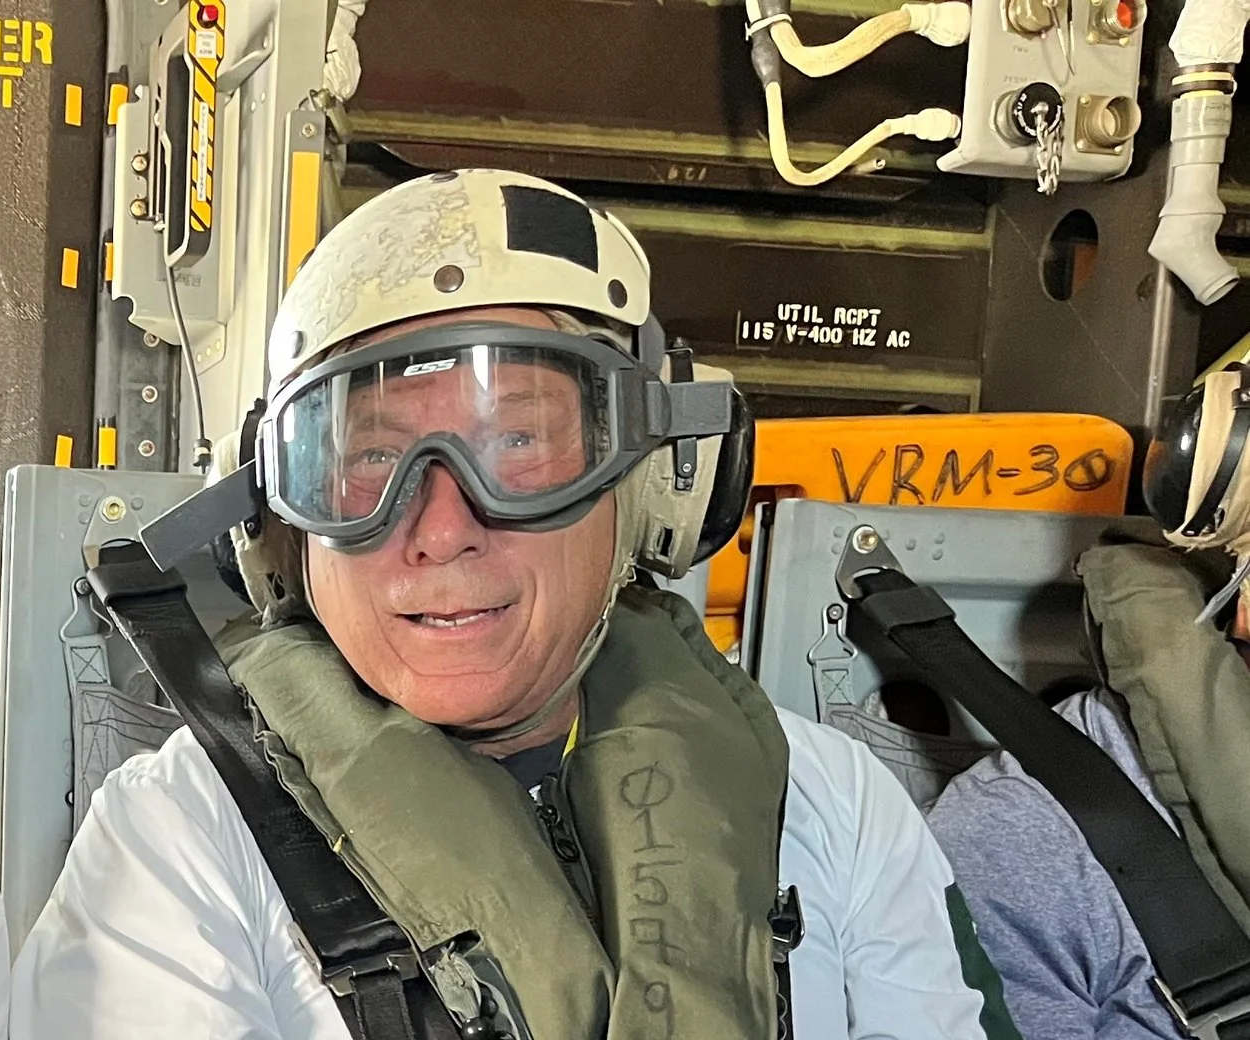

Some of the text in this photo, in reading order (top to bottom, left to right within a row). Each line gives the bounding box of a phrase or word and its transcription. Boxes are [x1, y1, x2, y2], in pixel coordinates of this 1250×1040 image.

[777, 302, 882, 327] UTIL RCPT
[741, 320, 776, 341] 115
[852, 327, 877, 347] HZ
[885, 329, 911, 348] AC
[402, 357, 457, 377] ESS
